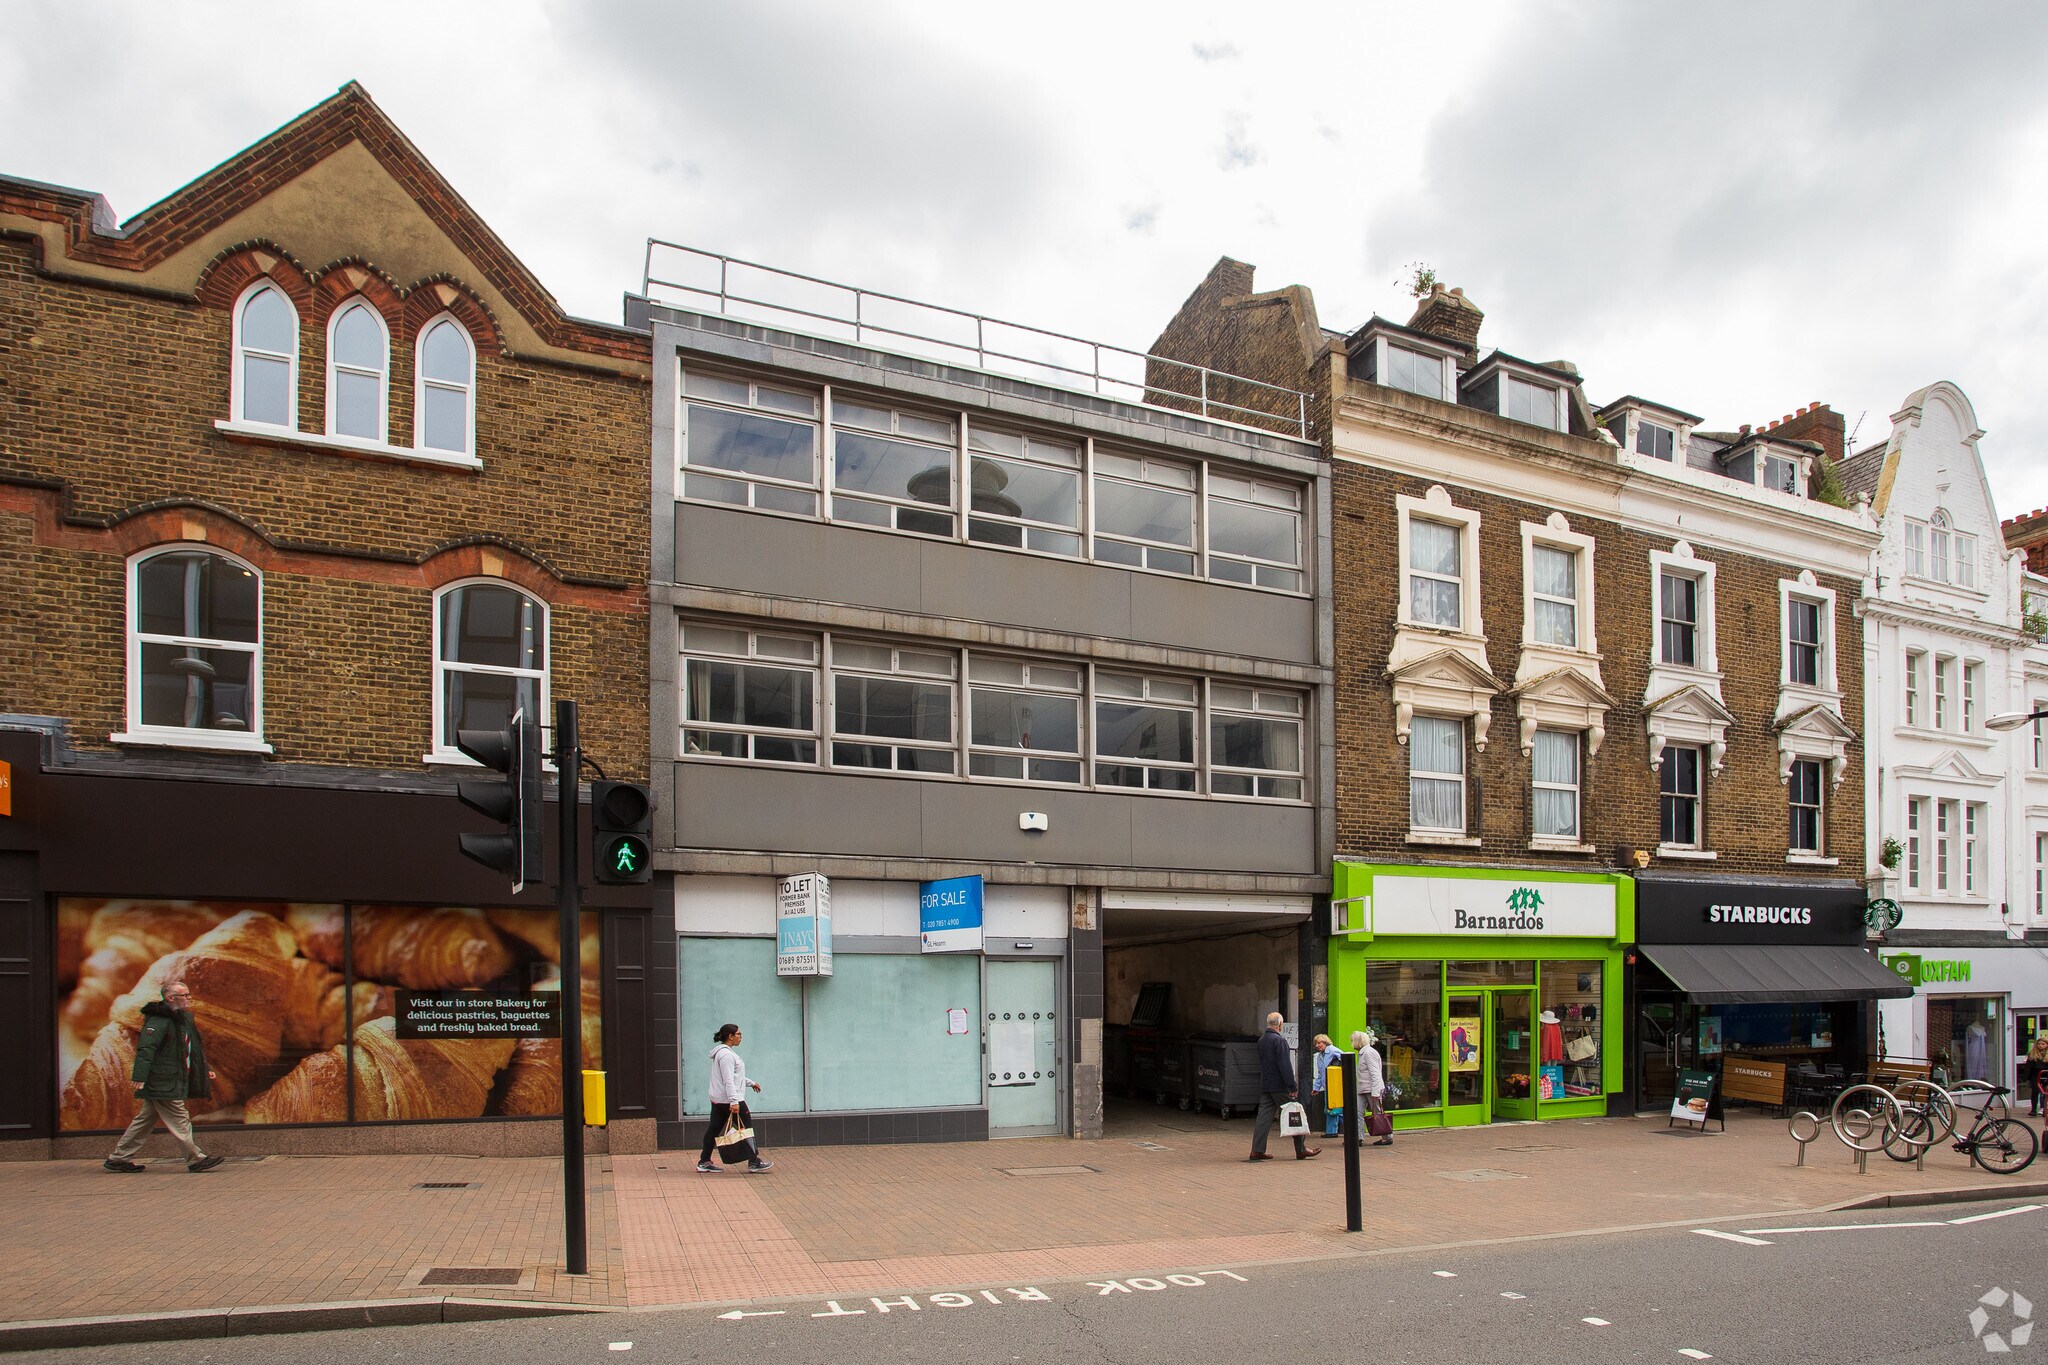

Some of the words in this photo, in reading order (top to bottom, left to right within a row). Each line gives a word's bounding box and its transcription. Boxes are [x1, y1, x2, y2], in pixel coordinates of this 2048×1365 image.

[779, 882, 791, 894] TO
[793, 879, 811, 892] LET
[780, 894, 796, 902] FORMER
[797, 892, 810, 900] BANK
[921, 893, 939, 909] FOR
[941, 890, 966, 907] SALE
[784, 900, 805, 908] PREMISES
[796, 907, 806, 915] USE
[1709, 904, 1811, 925] STARBUCKS
[1454, 909, 1544, 930] Barnardos
[778, 929, 814, 952] LINAYS
[779, 956, 795, 965] 01689
[796, 955, 816, 964] 875511
[1921, 960, 1971, 982] OXFAM
[410, 998, 433, 1008] Visit
[436, 1000, 453, 1008] our
[456, 998, 465, 1008] in
[468, 999, 493, 1008] store
[495, 998, 530, 1009] Bakery
[533, 998, 547, 1008] for
[407, 1011, 453, 1020] delicious
[455, 1011, 499, 1021] pastries,
[501, 1011, 550, 1021] baguettes
[417, 1023, 437, 1032] and
[439, 1023, 475, 1033] freshly
[477, 1023, 507, 1032] baked
[510, 1023, 541, 1032] bread.
[1735, 1067, 1772, 1078] STARBUCKS
[1086, 1270, 1248, 1296] LOOK
[811, 1286, 1052, 1317] RIGHT
